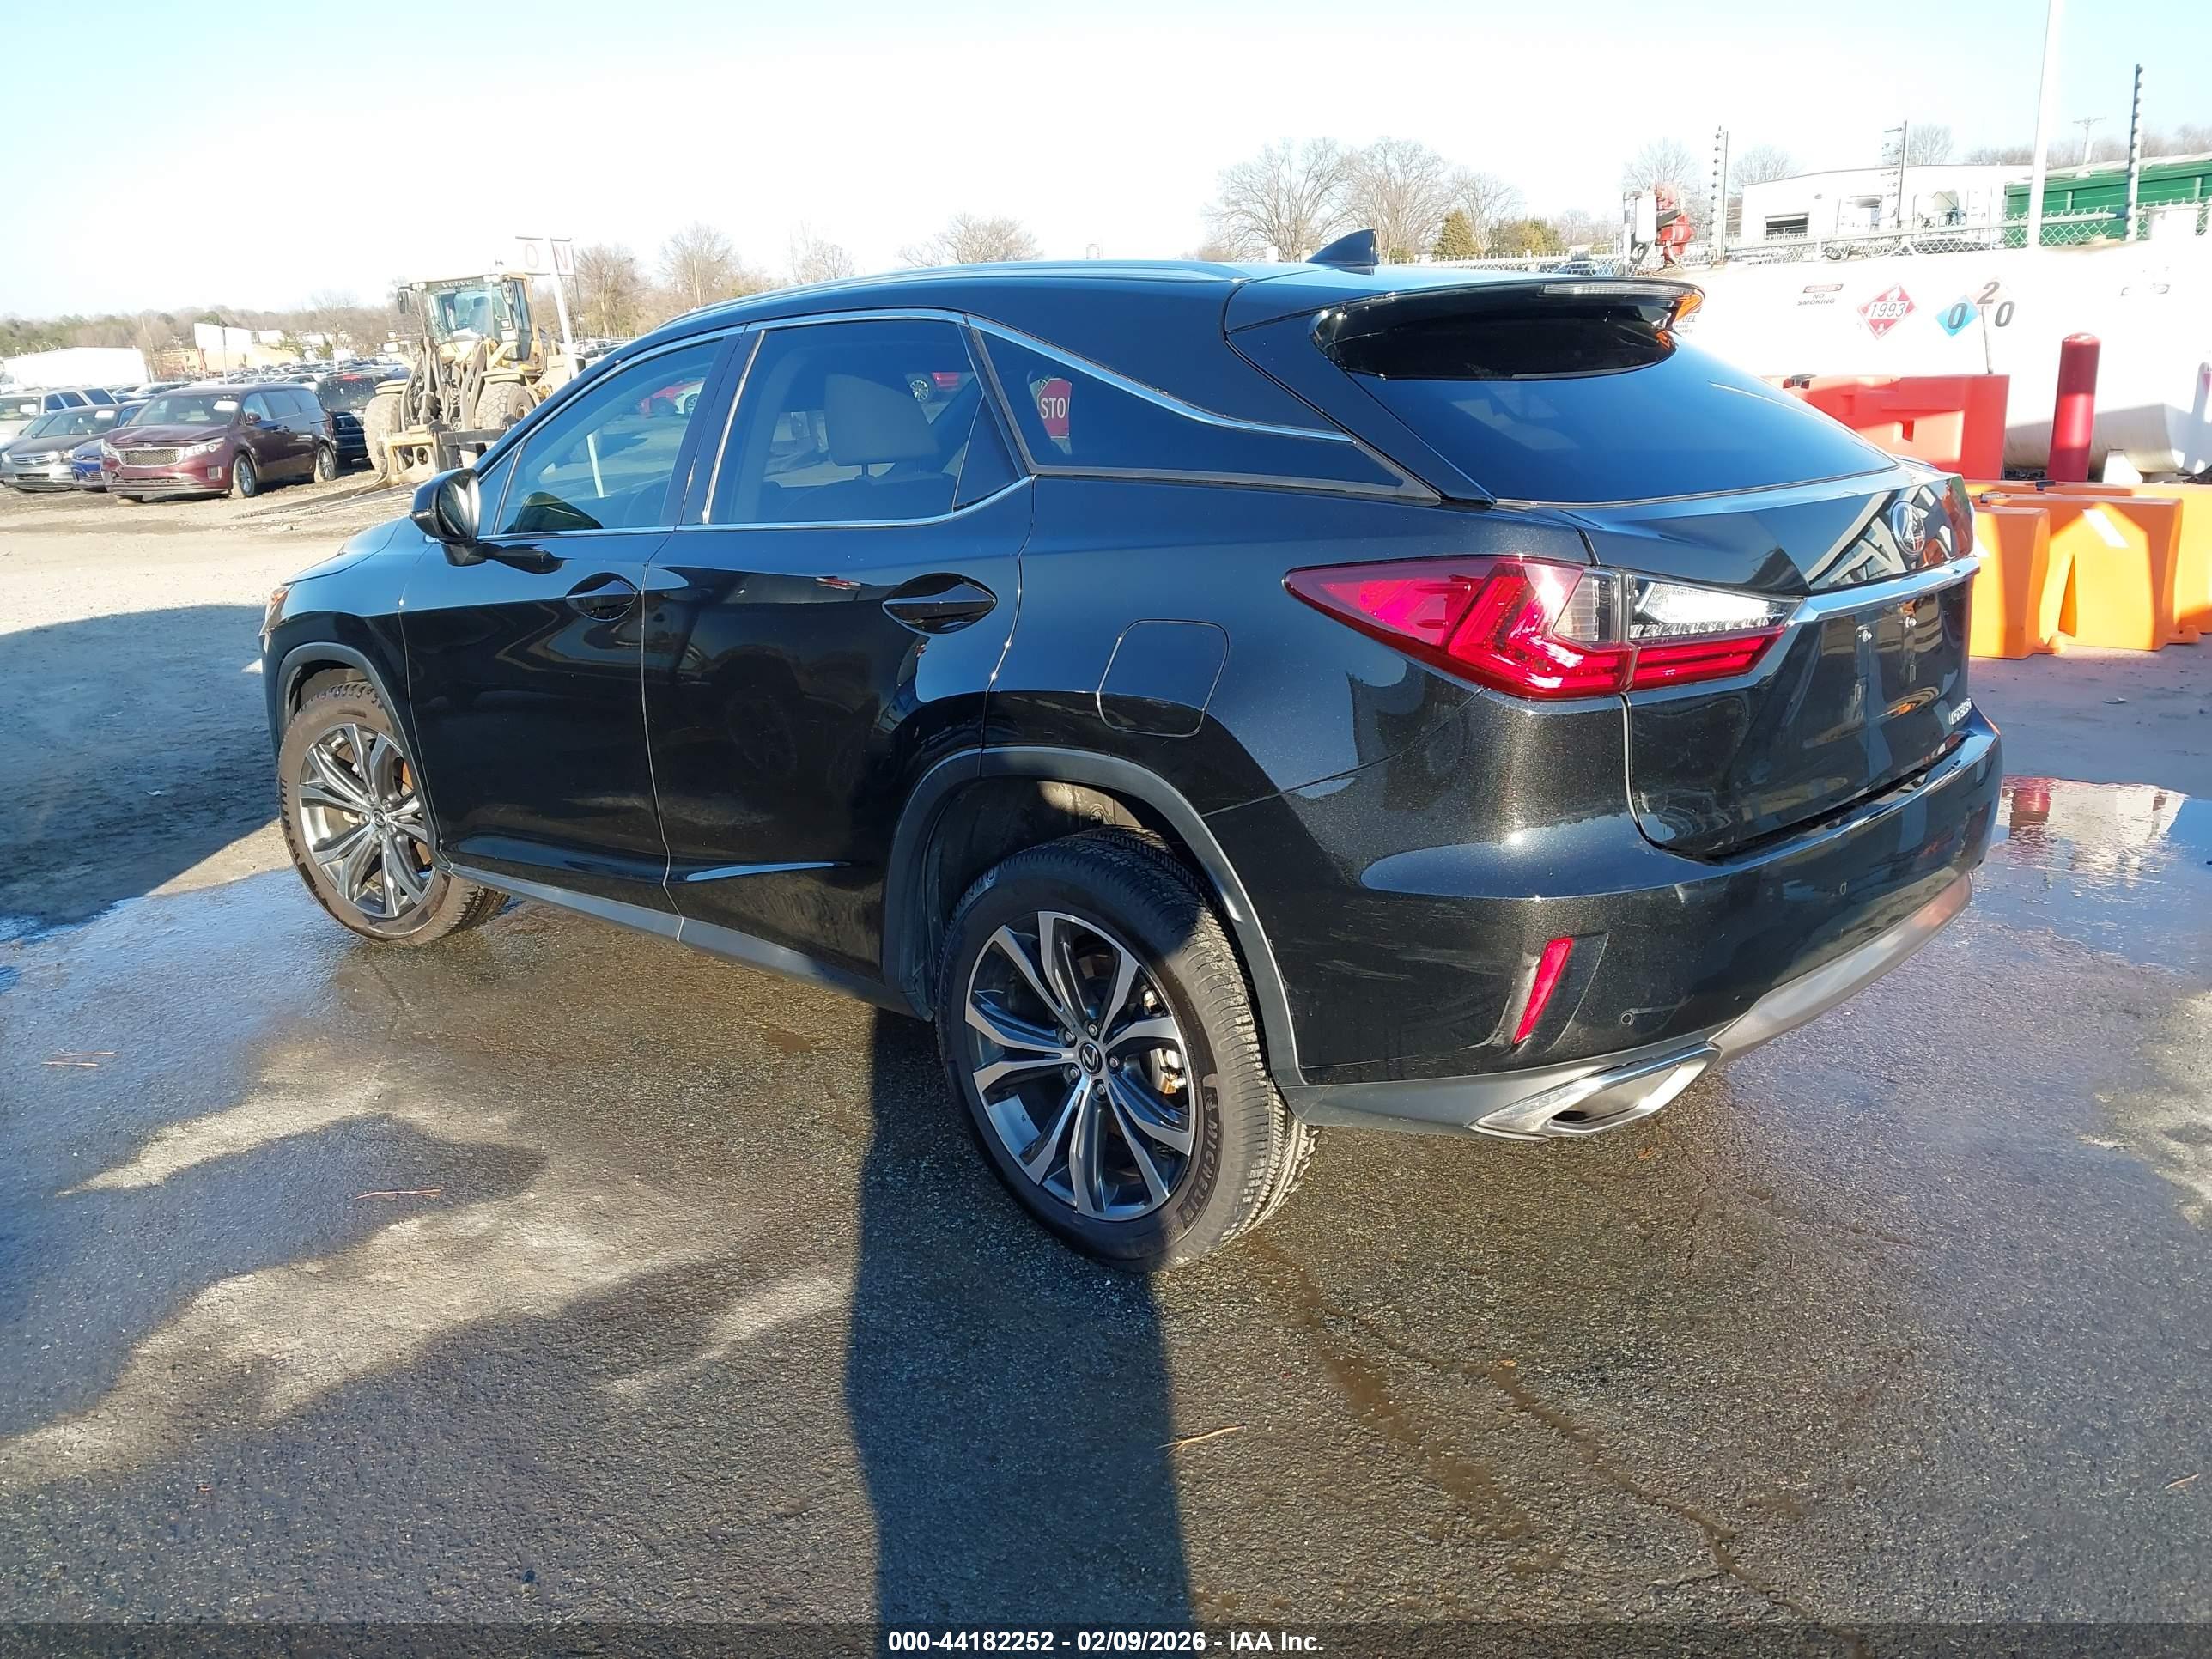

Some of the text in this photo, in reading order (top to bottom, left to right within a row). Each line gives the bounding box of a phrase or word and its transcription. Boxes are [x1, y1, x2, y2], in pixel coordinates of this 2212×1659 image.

[1797, 298, 1836, 307] SMOKING
[1976, 281, 2000, 305] 2
[1870, 302, 1906, 318] 1993
[1947, 302, 1968, 330] 0
[1994, 301, 2015, 328] 0
[1040, 397, 1070, 420] STO
[1182, 1118, 1218, 1224] MICHELIN
